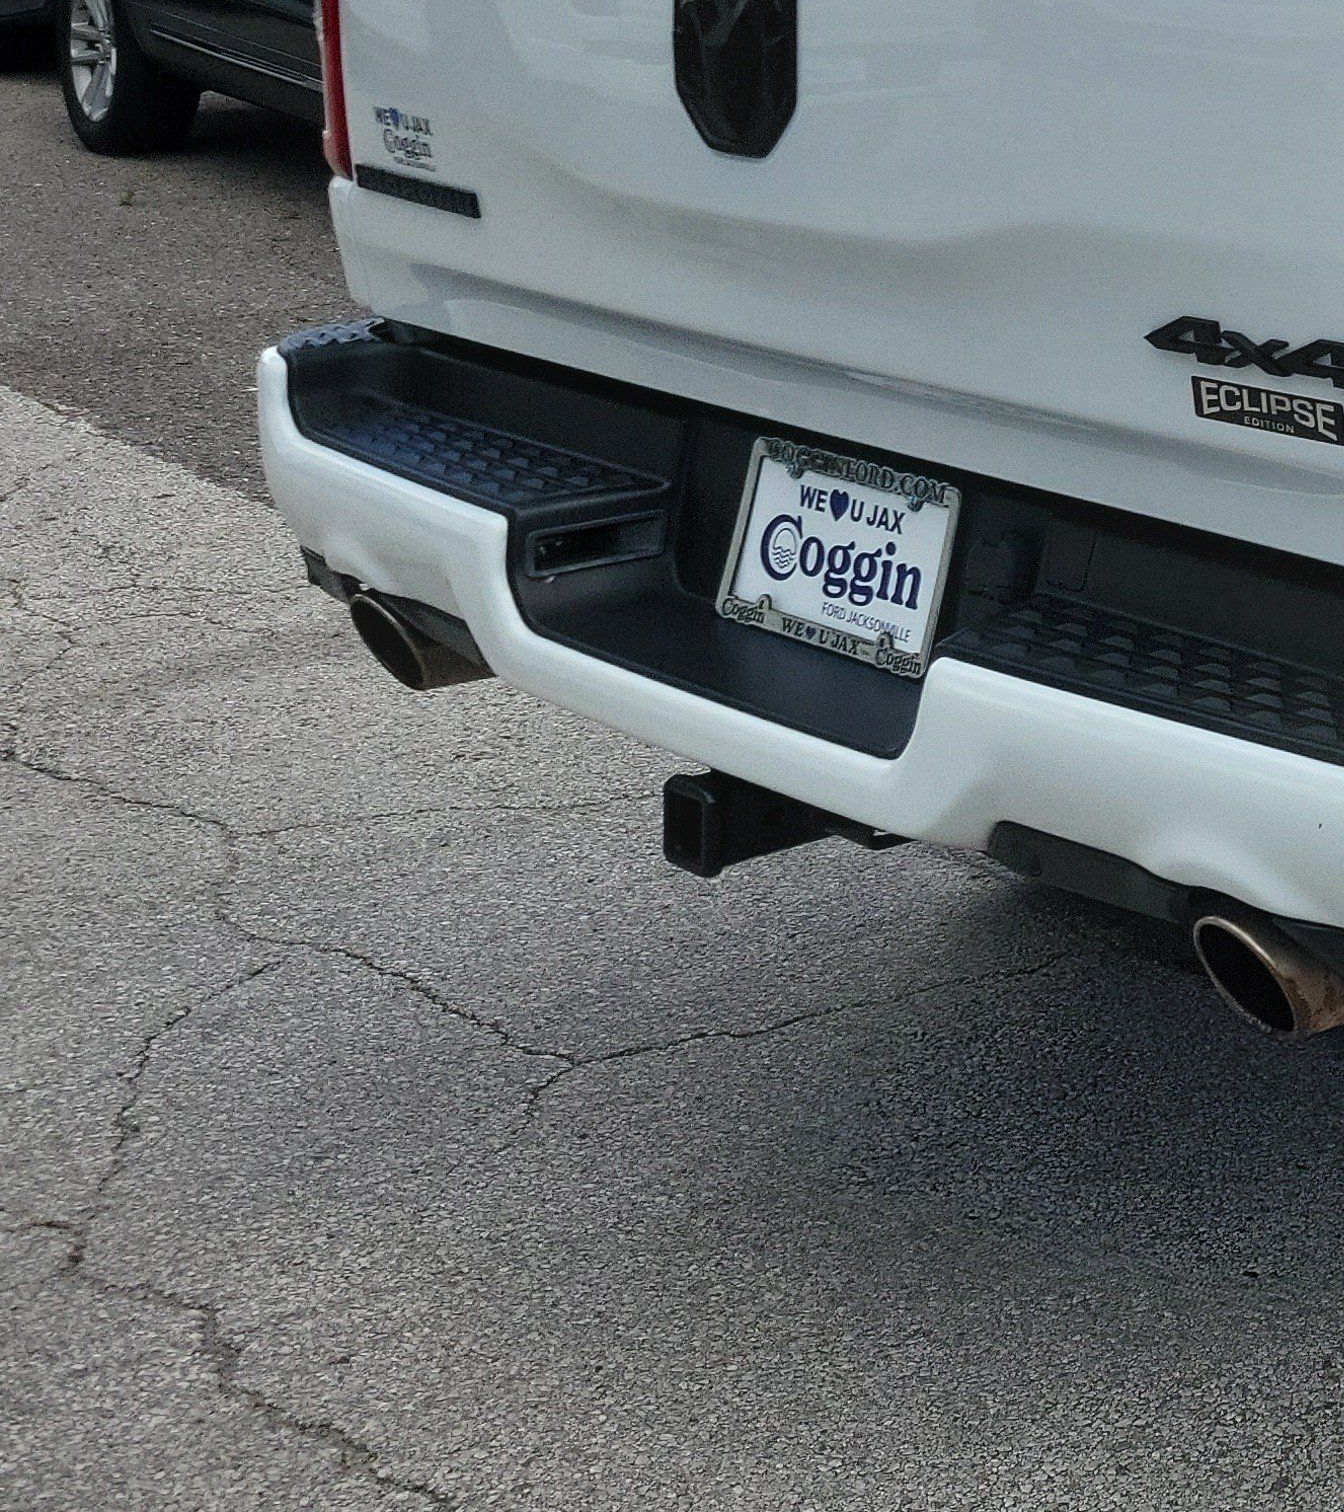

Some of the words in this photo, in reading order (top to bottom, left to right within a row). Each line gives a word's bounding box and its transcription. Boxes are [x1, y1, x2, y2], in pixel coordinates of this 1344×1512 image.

[1199, 381, 1339, 442] ECLIPSE
[1243, 415, 1295, 434] EDITION
[800, 484, 829, 513] WE
[850, 498, 865, 523] U
[866, 504, 906, 535] JAX
[760, 513, 922, 611] Coggin
[781, 616, 805, 638] WE
[818, 628, 830, 645] U
[831, 632, 861, 656] JAX
[821, 601, 846, 620] FORD
[846, 609, 912, 644] JACKSONVILLE
[874, 648, 922, 676] Coggin
